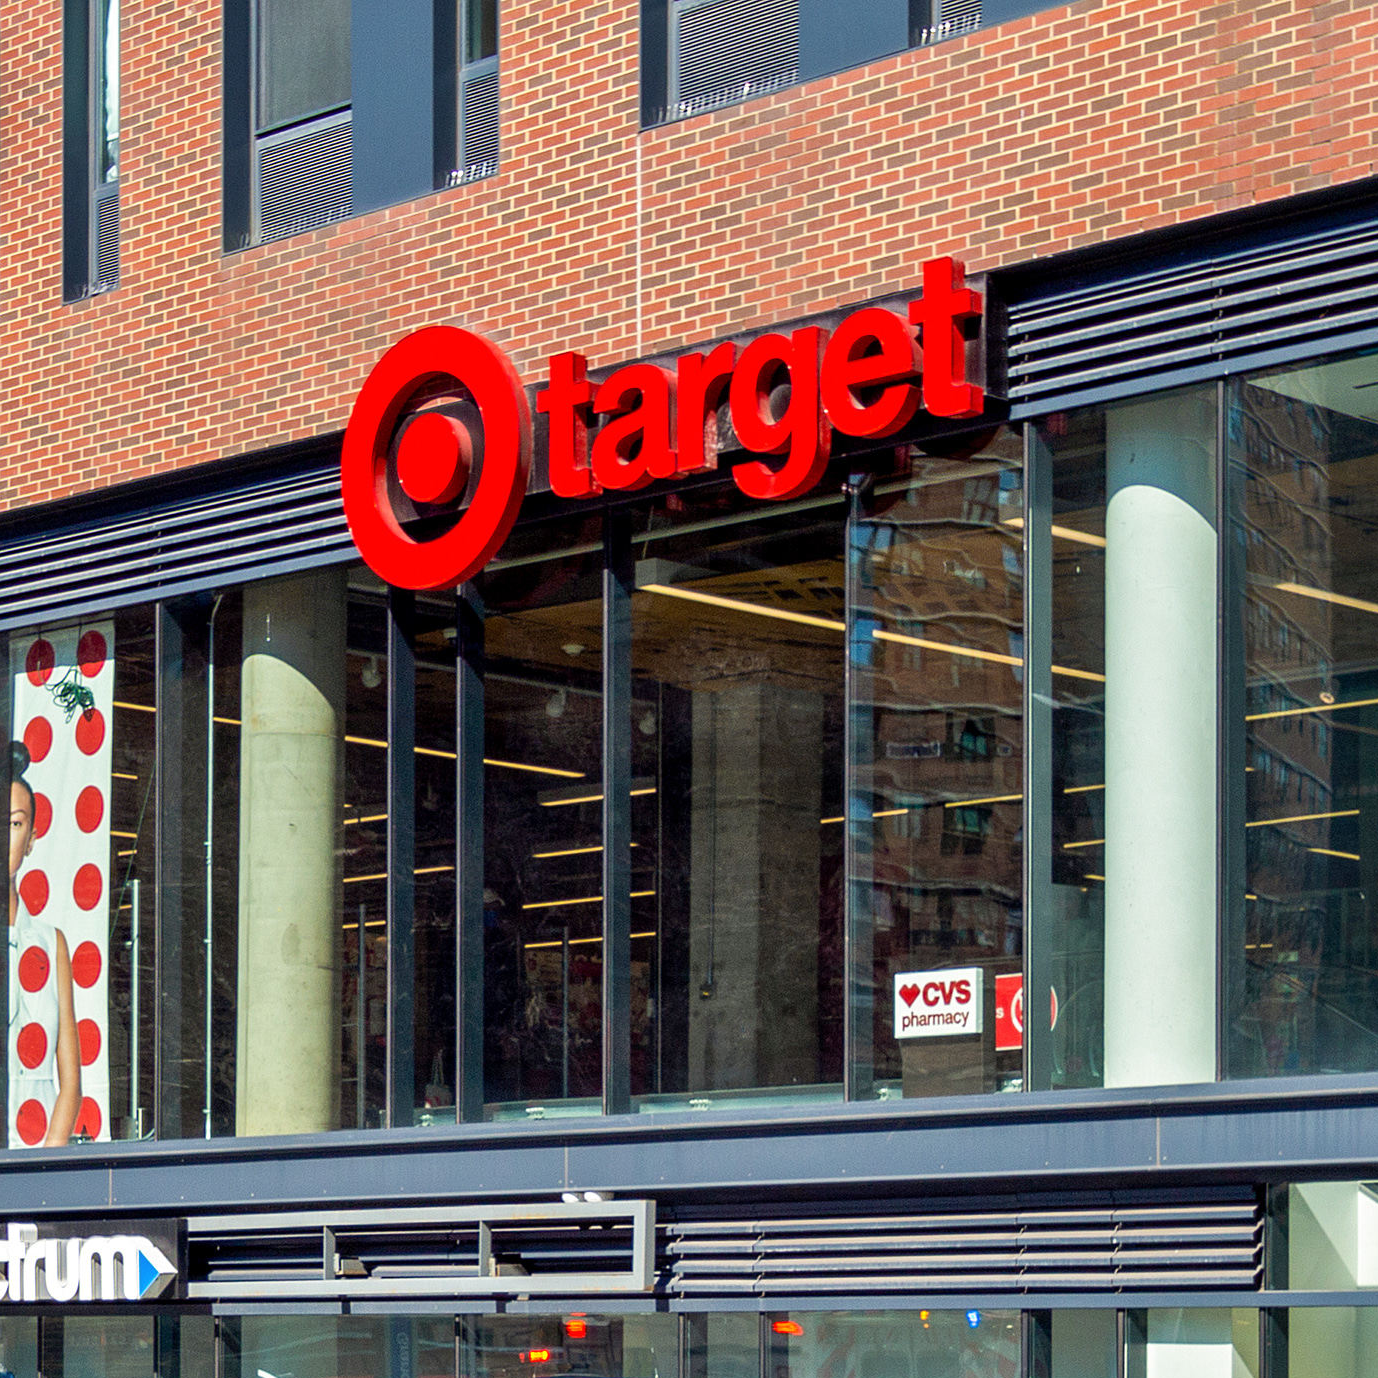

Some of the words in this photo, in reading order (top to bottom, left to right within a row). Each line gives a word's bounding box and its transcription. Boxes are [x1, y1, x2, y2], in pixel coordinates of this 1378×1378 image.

[536, 255, 983, 500] target
[922, 979, 971, 1007] CVS
[902, 1011, 970, 1032] pharmacy
